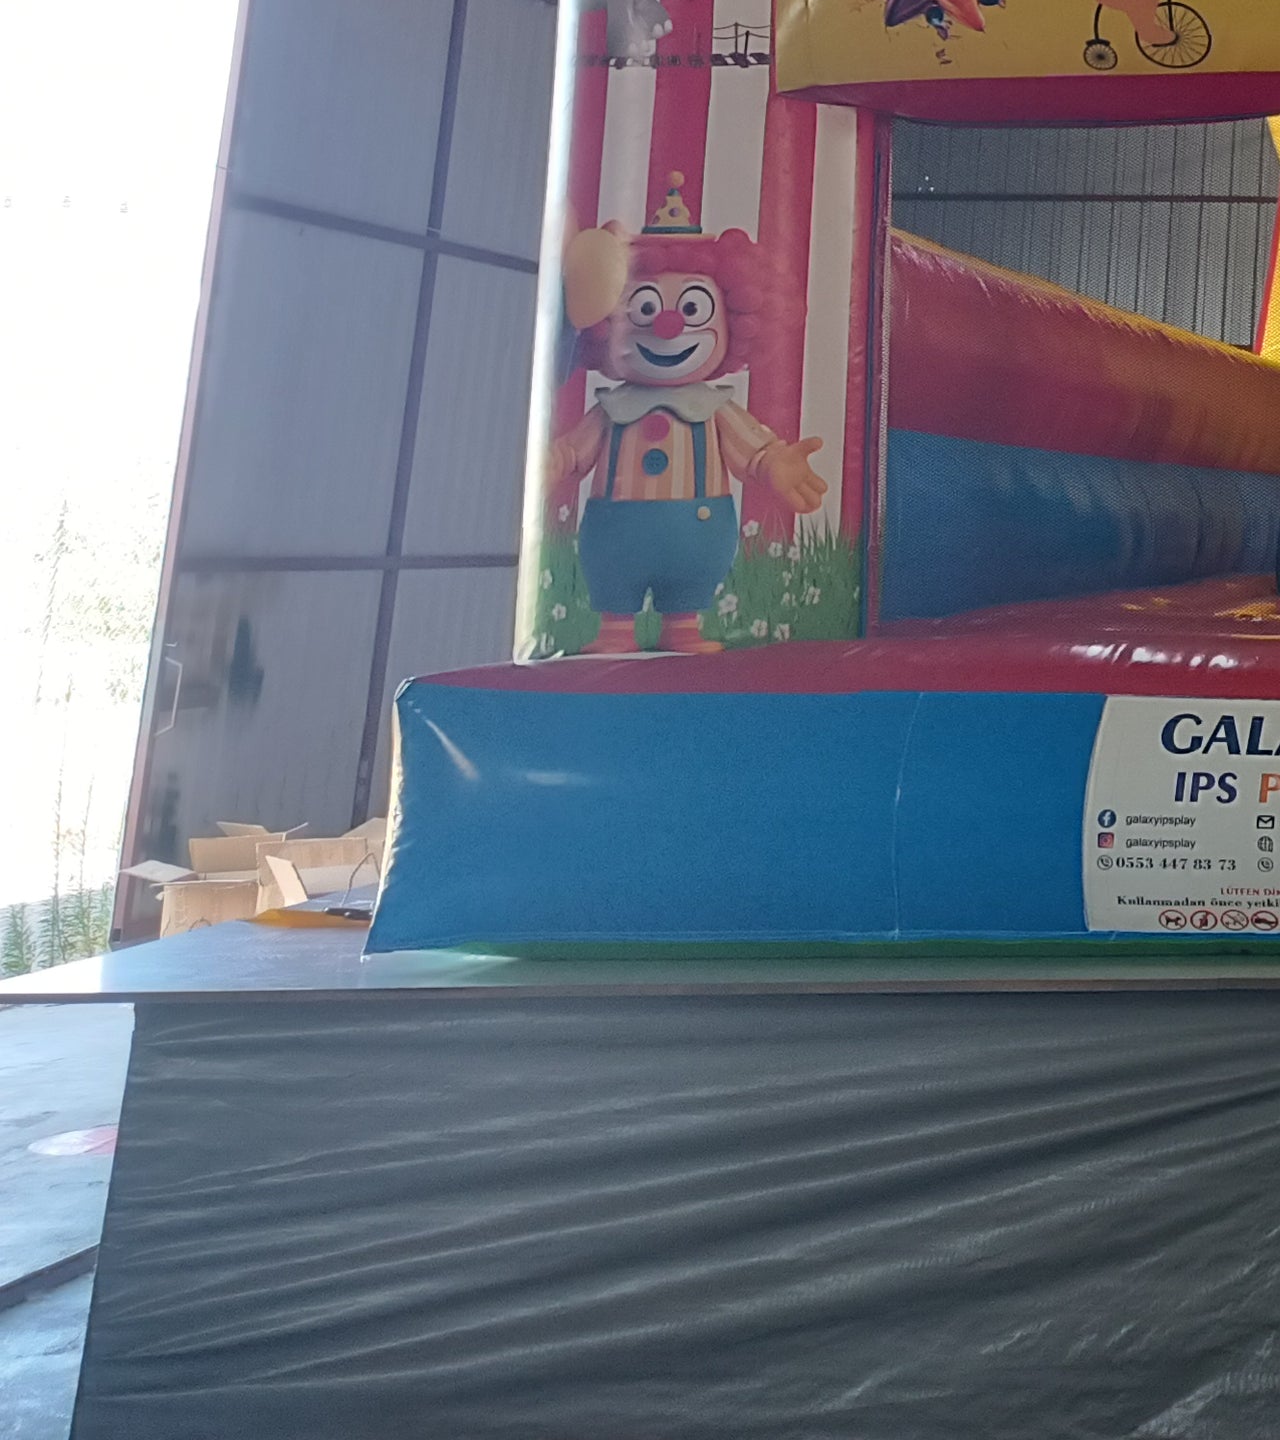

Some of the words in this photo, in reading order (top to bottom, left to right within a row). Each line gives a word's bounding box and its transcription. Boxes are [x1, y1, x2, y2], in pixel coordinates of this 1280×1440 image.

[1174, 771, 1238, 804] IPS
[1125, 814, 1197, 827] galaxyipsplay
[1125, 837, 1197, 850] galaxyipsplay
[1115, 856, 1154, 869] 0553
[1192, 858, 1212, 871] 83
[1218, 858, 1237, 871] 73
